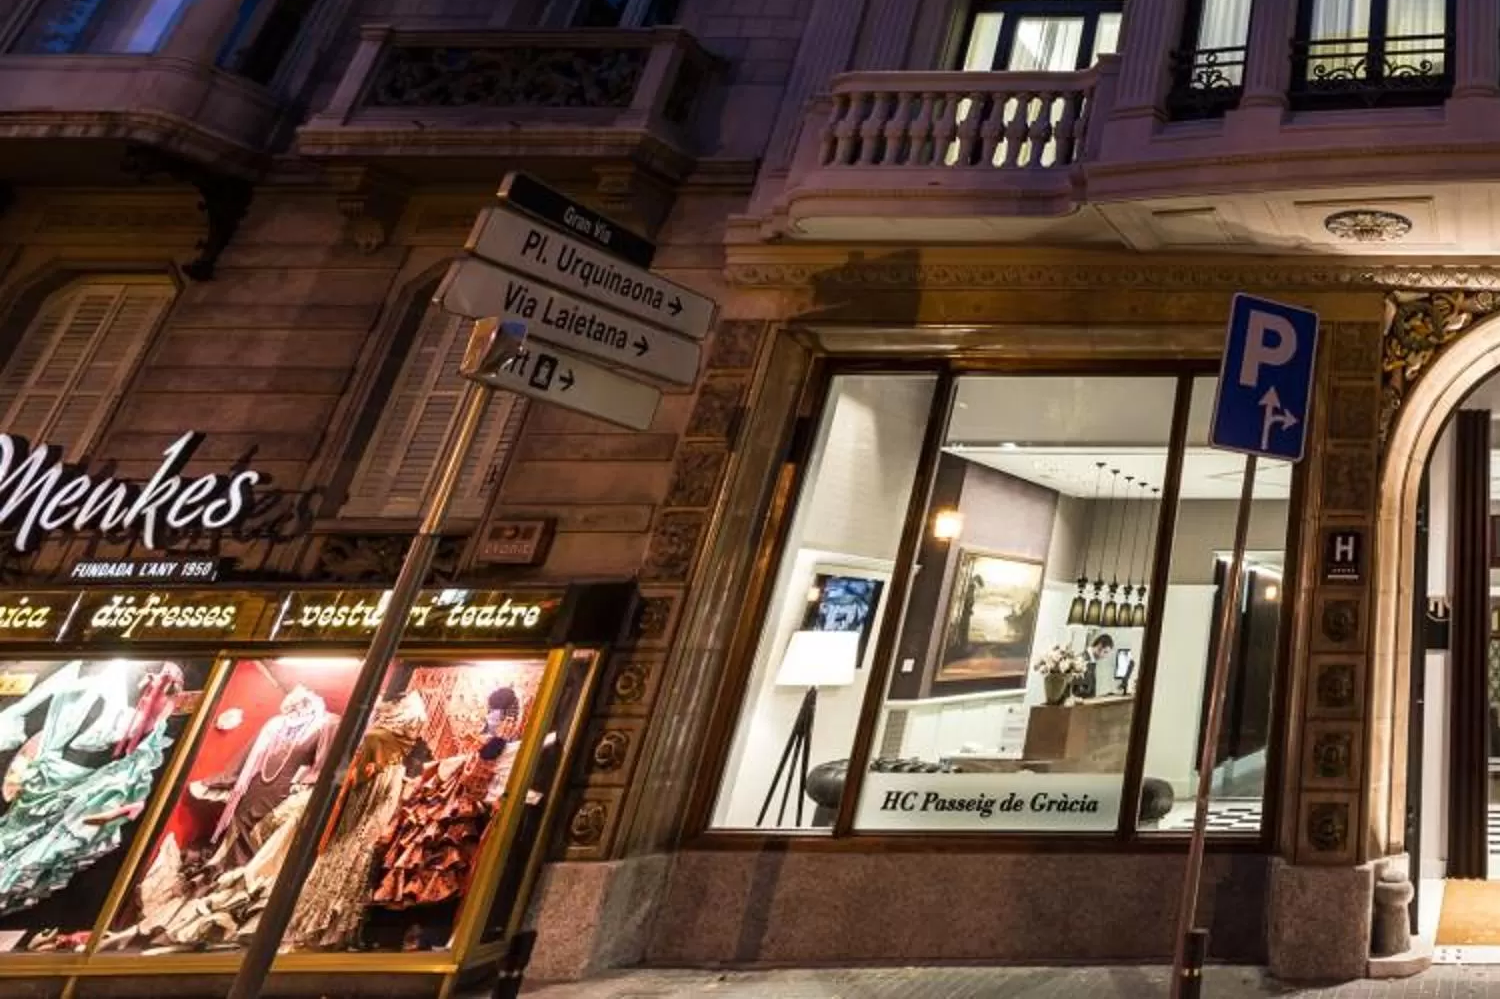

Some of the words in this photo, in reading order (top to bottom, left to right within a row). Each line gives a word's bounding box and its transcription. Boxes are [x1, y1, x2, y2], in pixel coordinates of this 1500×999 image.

[520, 230, 548, 265] Pl.
[556, 244, 664, 311] Urquinaona
[504, 281, 536, 319] Via
[542, 296, 629, 350] Laietana
[1239, 309, 1297, 388] P
[71, 562, 134, 578] FUNDADA
[1334, 536, 1355, 563] H
[91, 595, 236, 638] disfresses
[446, 601, 541, 629] teatre
[881, 791, 917, 812] HC
[920, 791, 997, 818] Passeig
[1000, 793, 1024, 812] de
[1030, 793, 1099, 813] Gràcia
